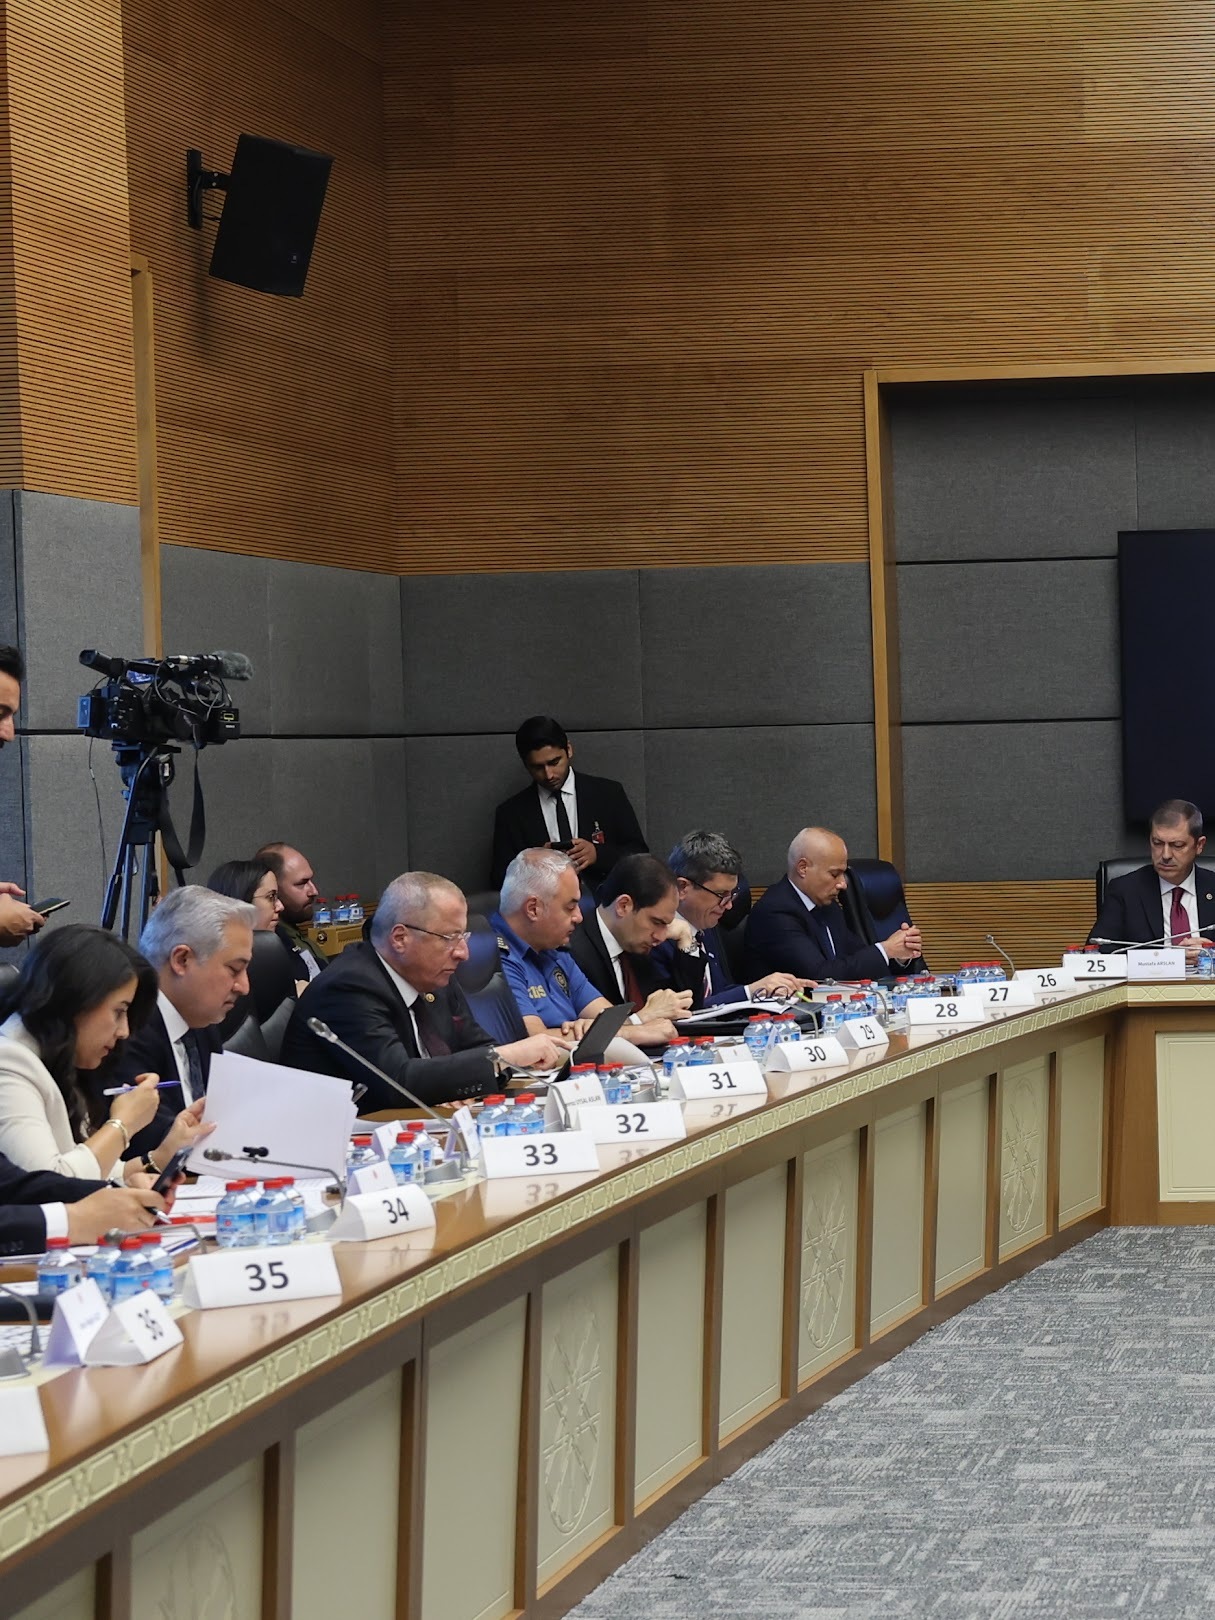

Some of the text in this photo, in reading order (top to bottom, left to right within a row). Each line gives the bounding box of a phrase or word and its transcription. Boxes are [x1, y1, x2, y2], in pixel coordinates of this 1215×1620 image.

[1086, 959, 1107, 973] 25
[1037, 973, 1057, 988] 26
[988, 987, 1009, 1002] 27
[934, 1002, 959, 1018] 28
[859, 1024, 877, 1041] 29
[803, 1045, 828, 1062] 30
[708, 1071, 738, 1090] 31
[615, 1112, 650, 1135] 32
[523, 1142, 560, 1167] 33
[382, 1197, 410, 1225] 34
[244, 1260, 290, 1292] 35
